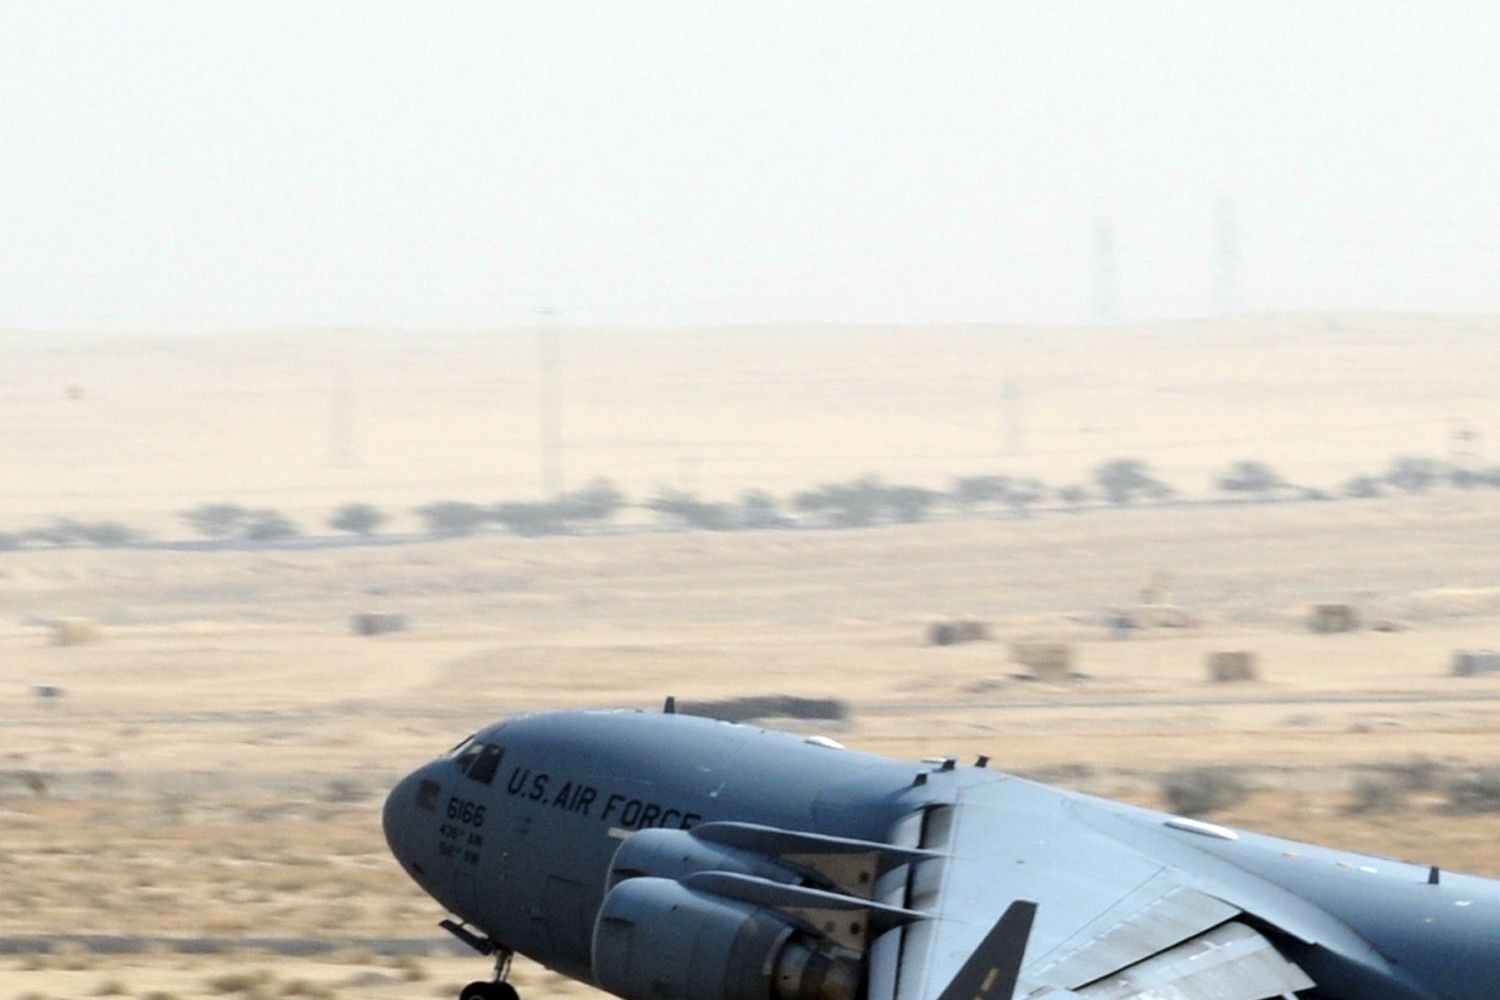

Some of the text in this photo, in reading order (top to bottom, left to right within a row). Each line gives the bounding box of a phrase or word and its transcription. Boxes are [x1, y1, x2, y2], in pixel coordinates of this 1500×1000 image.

[447, 796, 487, 828] 6166
[507, 767, 702, 829] U.S. AIR FORCE
